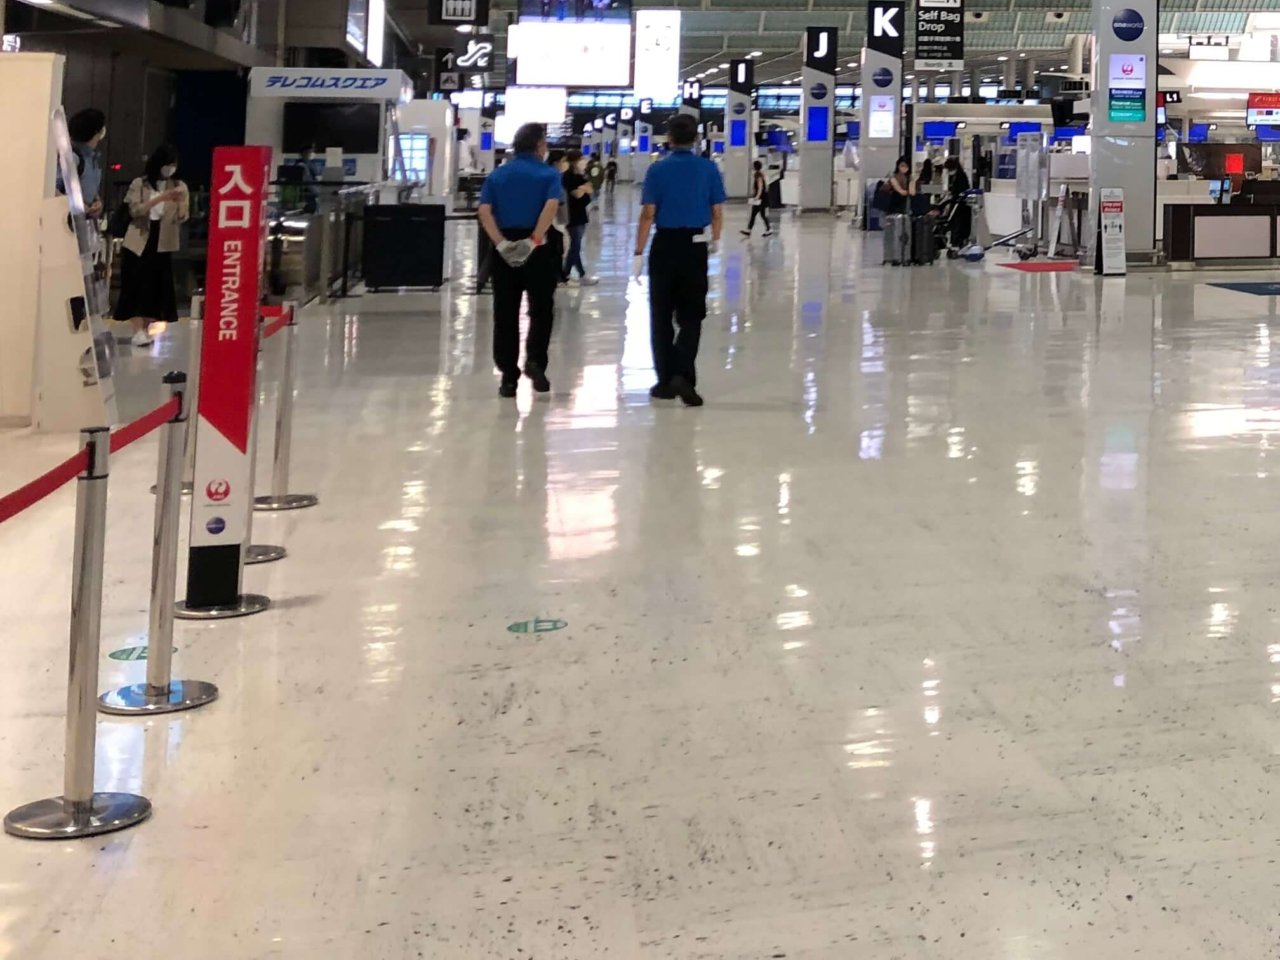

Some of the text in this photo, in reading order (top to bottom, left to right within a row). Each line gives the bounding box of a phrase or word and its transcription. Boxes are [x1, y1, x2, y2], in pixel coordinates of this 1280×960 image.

[873, 7, 899, 37] K
[918, 11, 960, 23] Self Bag
[918, 22, 945, 33] Drop
[813, 32, 828, 58] J
[737, 62, 746, 83] I
[265, 76, 388, 89] テレコムスクエア
[683, 82, 699, 99] H
[1166, 93, 1178, 102] L1
[484, 93, 495, 107] F
[641, 100, 652, 114] E
[605, 113, 616, 125] C
[620, 108, 634, 120] D
[583, 122, 593, 132] A
[218, 164, 254, 229] 入口
[218, 240, 242, 341] ENTRANCE
